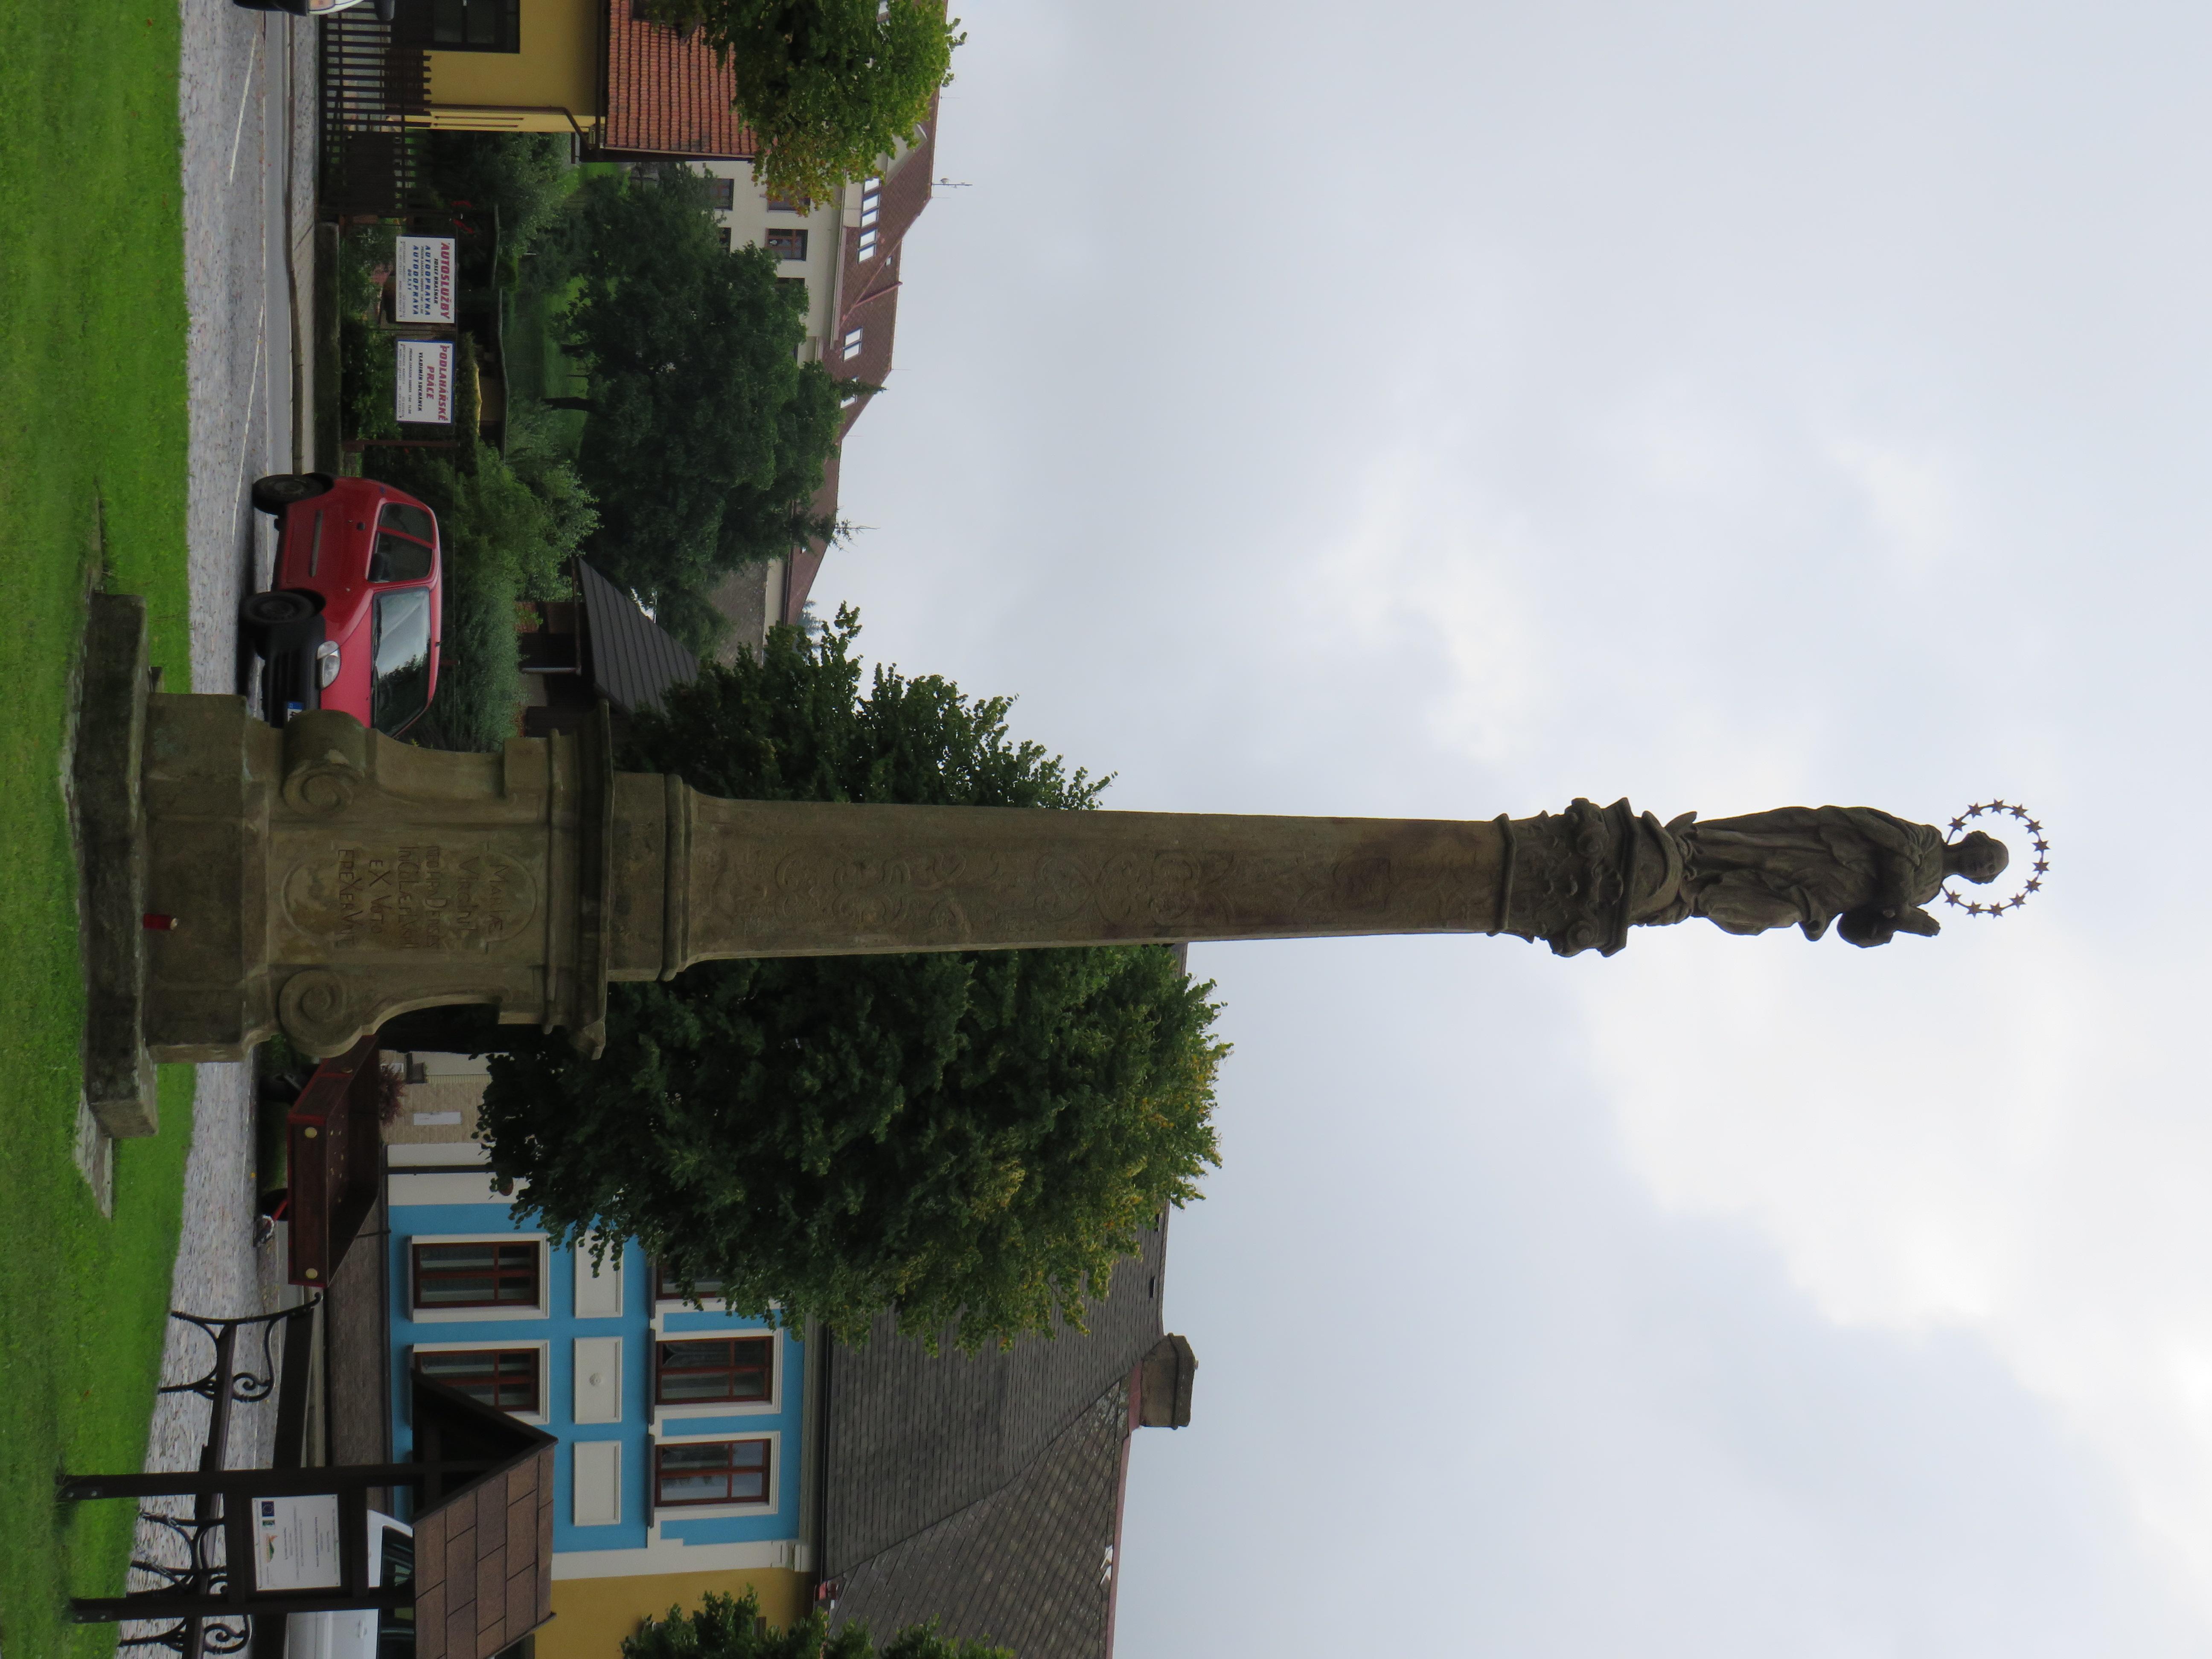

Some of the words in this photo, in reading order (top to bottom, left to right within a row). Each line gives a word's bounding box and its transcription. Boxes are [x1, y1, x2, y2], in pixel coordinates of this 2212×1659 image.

[441, 242, 451, 319] AUTOSLUŽBY
[427, 366, 436, 399] PRÁCE
[438, 345, 448, 420] PODLAHÁŘSKÉ
[368, 859, 392, 887] EX
[370, 895, 393, 934] VOTO
